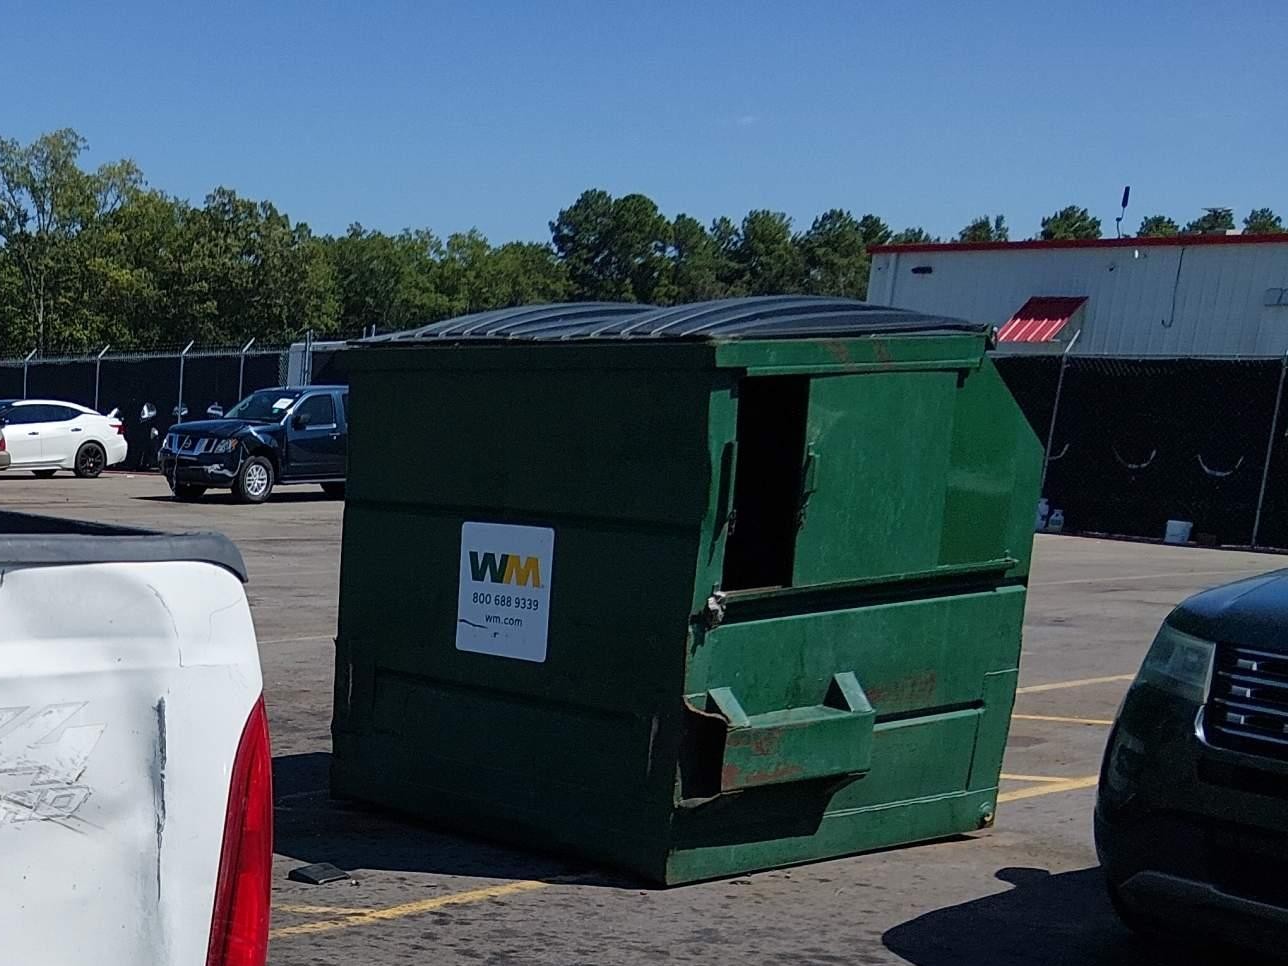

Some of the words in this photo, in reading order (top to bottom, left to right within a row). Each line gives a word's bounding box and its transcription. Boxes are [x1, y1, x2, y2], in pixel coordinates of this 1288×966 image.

[469, 551, 541, 588] WM
[472, 592, 492, 605] 800
[494, 595, 512, 608] 688
[514, 597, 539, 611] 9339
[485, 614, 523, 627] wm.com
